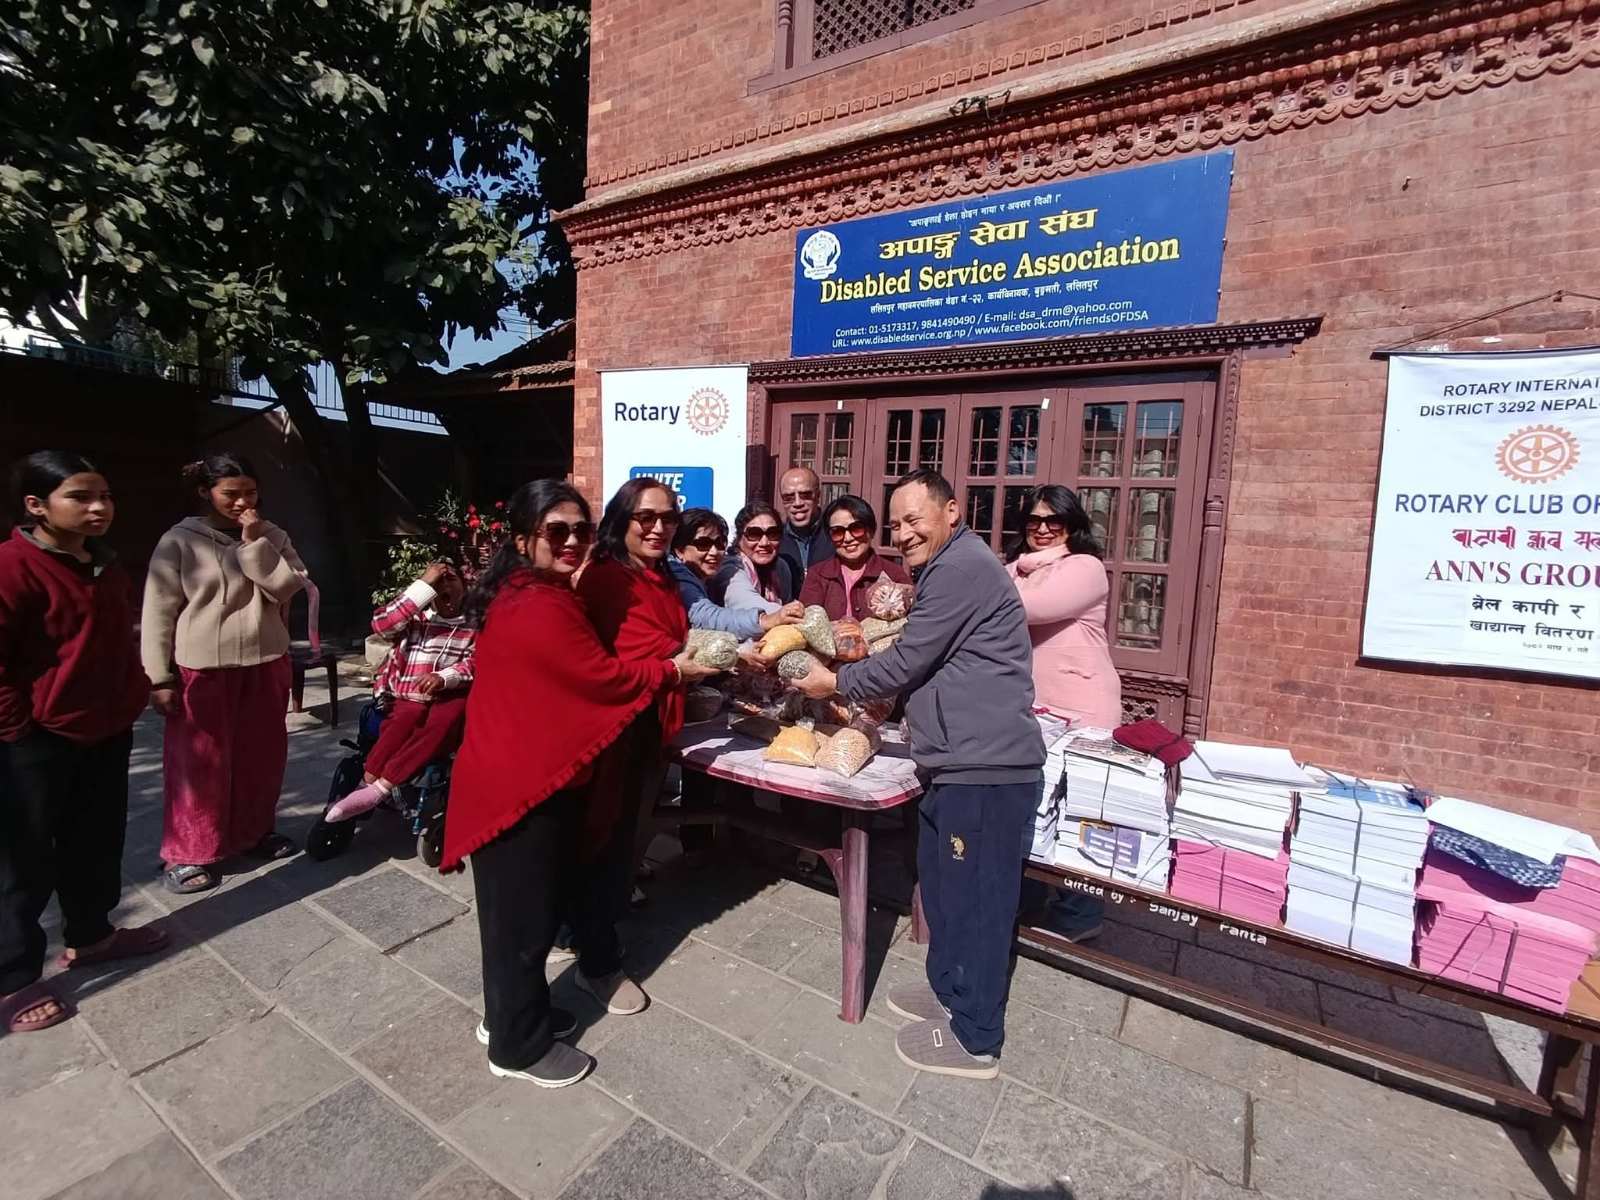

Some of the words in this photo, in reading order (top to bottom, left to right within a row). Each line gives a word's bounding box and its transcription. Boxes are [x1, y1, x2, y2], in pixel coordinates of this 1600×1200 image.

[999, 203, 1005, 212] र
[969, 220, 1029, 246] सेवा
[1039, 208, 1098, 236] संघ
[820, 269, 911, 303] Disabled
[919, 258, 1007, 292] Service
[1013, 236, 1180, 279] Association
[870, 302, 895, 314] ललितपुर
[1066, 279, 1099, 293] ललितपुर
[832, 339, 849, 348] URL:
[851, 328, 966, 347] www.disabledservice.org.np
[967, 326, 973, 337] /
[975, 310, 1149, 336] www.facebook.com/friendsOFDSA
[835, 327, 867, 338] Contact:
[868, 322, 919, 334] 01-5173317,
[921, 315, 975, 330] 9841490490
[977, 313, 983, 324] /
[985, 311, 1016, 323] E-mail:
[1019, 300, 1133, 321] dsa_drm@yahoo.com
[1443, 381, 1512, 397] ROTARY
[614, 402, 680, 425] Rotary
[1420, 402, 1494, 417] DISTRICT
[1499, 400, 1536, 414] 3292
[1395, 494, 1488, 514] ROTARY
[1495, 494, 1563, 514] CLUB
[1425, 560, 1511, 584] ANN'S
[1472, 594, 1502, 611] ब्रेल
[1512, 598, 1559, 616] कापी
[1569, 604, 1585, 619] र
[1535, 622, 1595, 640] वितरण
